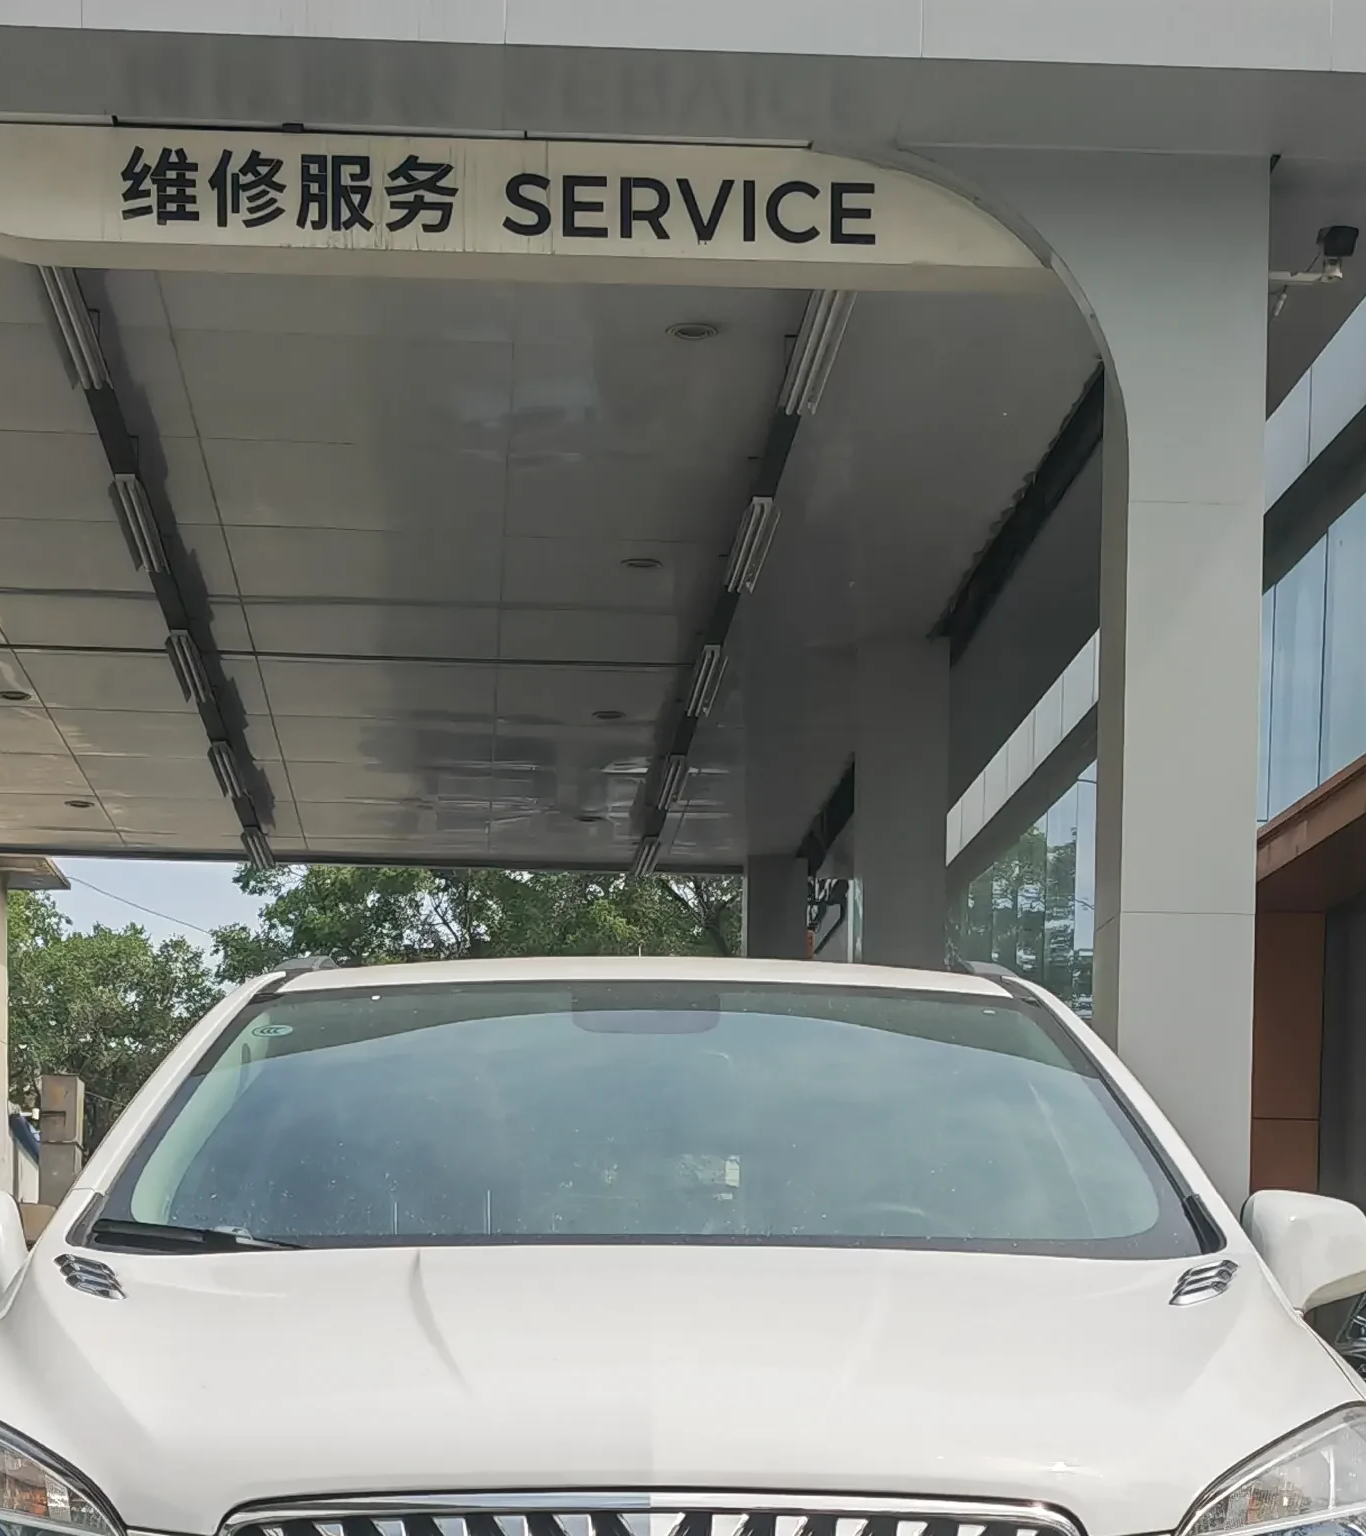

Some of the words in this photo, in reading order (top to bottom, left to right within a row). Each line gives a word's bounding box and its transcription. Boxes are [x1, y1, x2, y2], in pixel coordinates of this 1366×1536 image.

[120, 145, 460, 233] 维修服务
[502, 172, 877, 245] SERVICE
